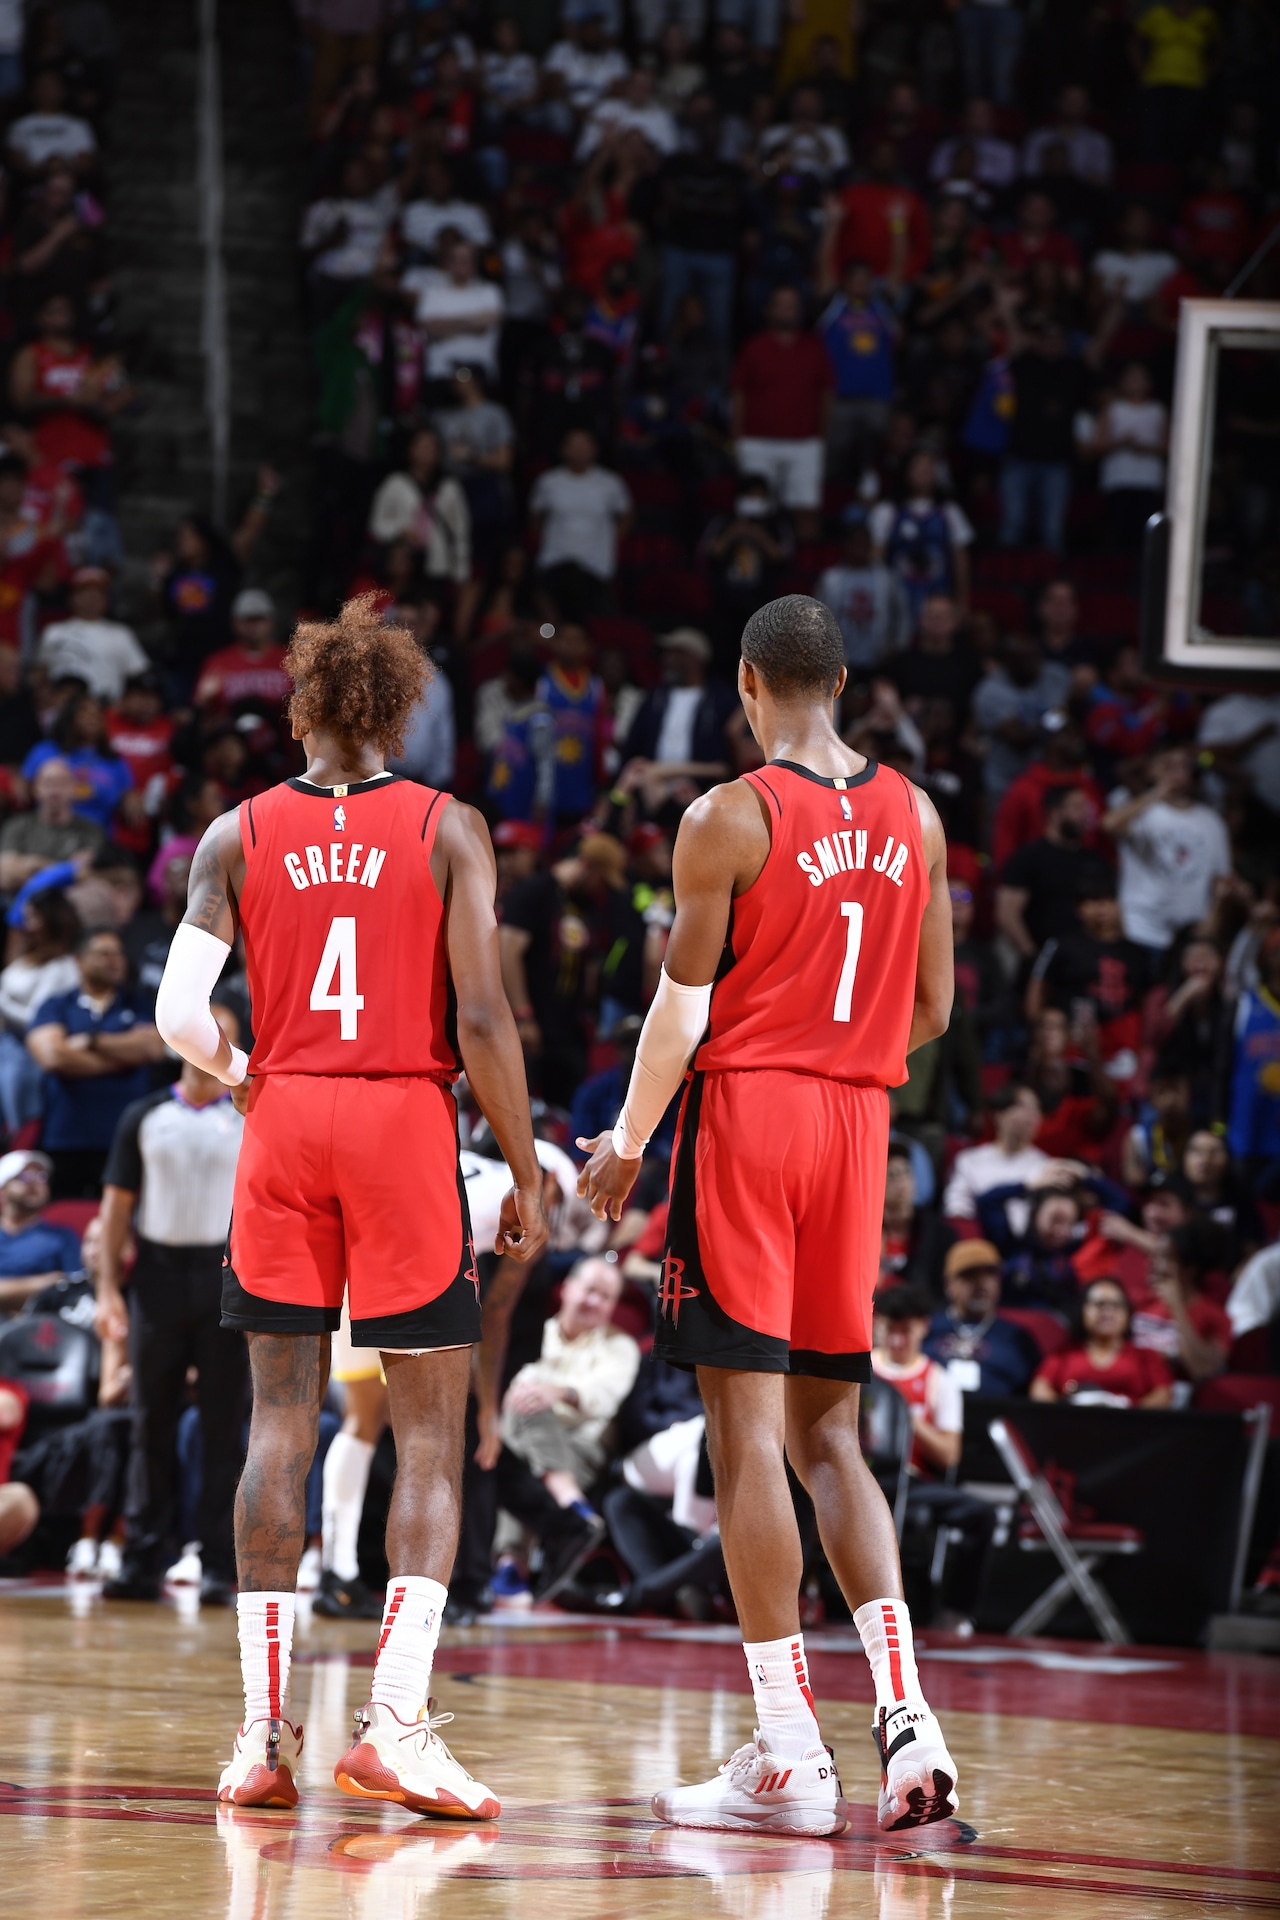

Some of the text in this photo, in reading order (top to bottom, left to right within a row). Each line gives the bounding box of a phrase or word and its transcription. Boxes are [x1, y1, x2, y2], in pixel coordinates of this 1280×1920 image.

[283, 842, 387, 891] GREEN
[796, 829, 909, 887] SMITH JR.
[309, 916, 365, 1041] 4
[832, 901, 864, 1023] 1
